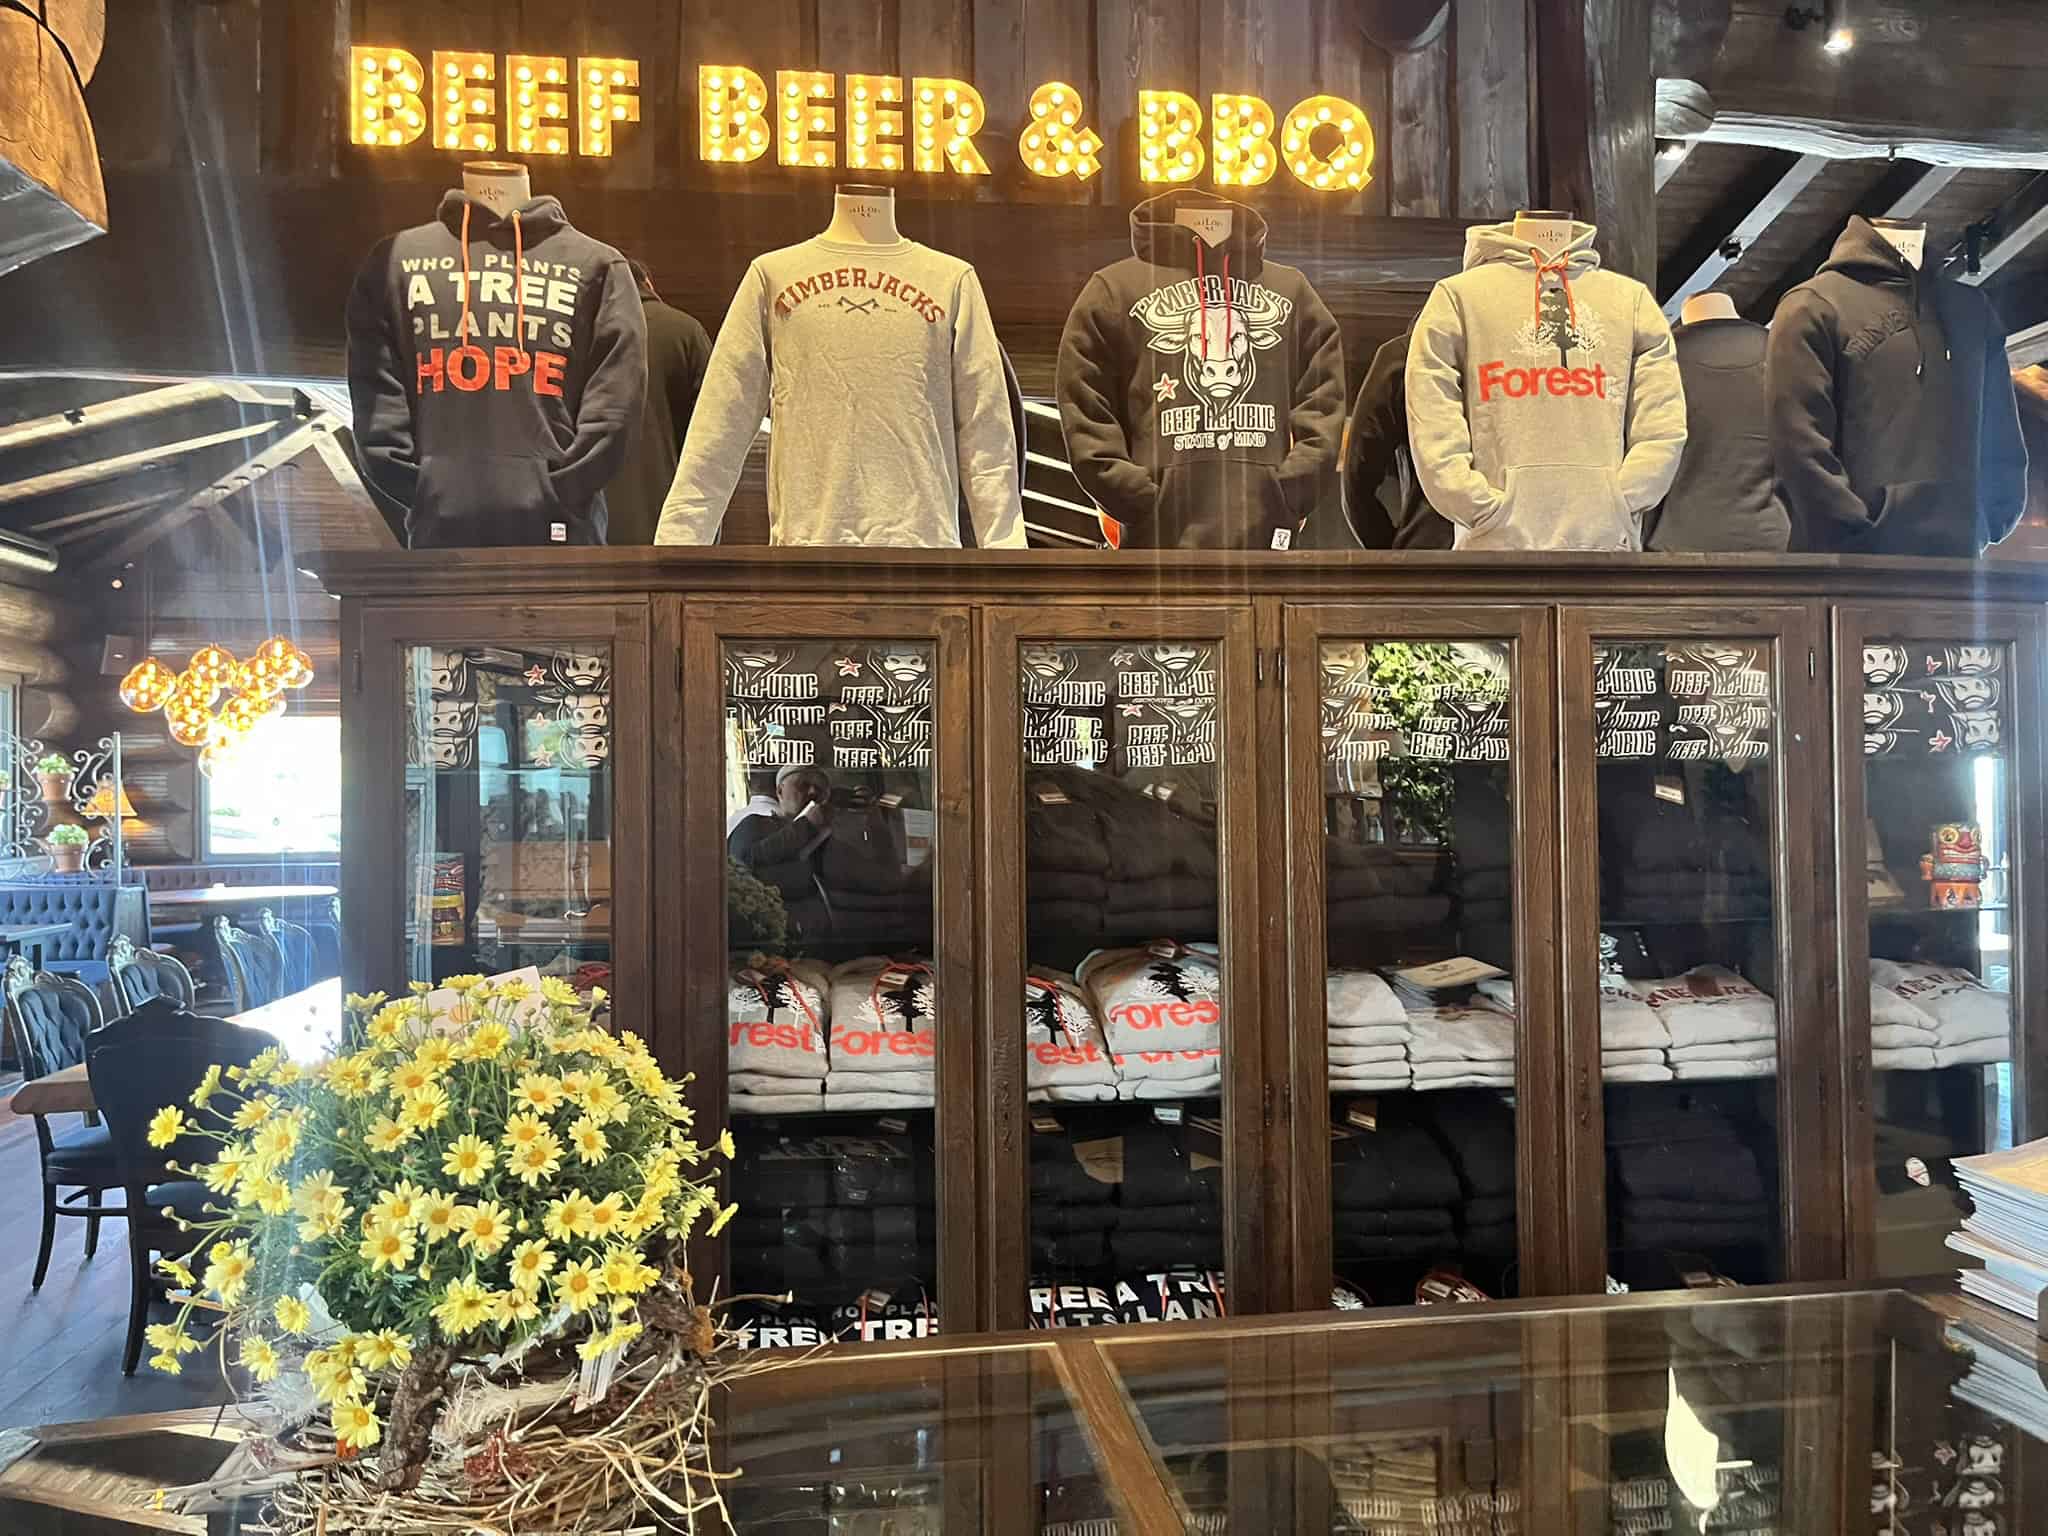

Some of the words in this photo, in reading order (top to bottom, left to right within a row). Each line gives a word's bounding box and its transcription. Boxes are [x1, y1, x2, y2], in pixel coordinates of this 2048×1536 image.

[350, 45, 640, 157] BEEF
[699, 64, 992, 175] BEER
[1019, 81, 1103, 182] &
[1139, 89, 1373, 192] BBQ
[402, 256, 456, 272] WHO
[485, 253, 582, 282] PLANTS
[407, 274, 436, 311] A
[448, 271, 578, 316] TREE
[774, 267, 946, 324] TIMBERJACKS
[416, 344, 568, 398] HOPE
[1477, 360, 1607, 402] Forest
[1160, 404, 1201, 437] BEEF
[1174, 433, 1215, 451] STATE
